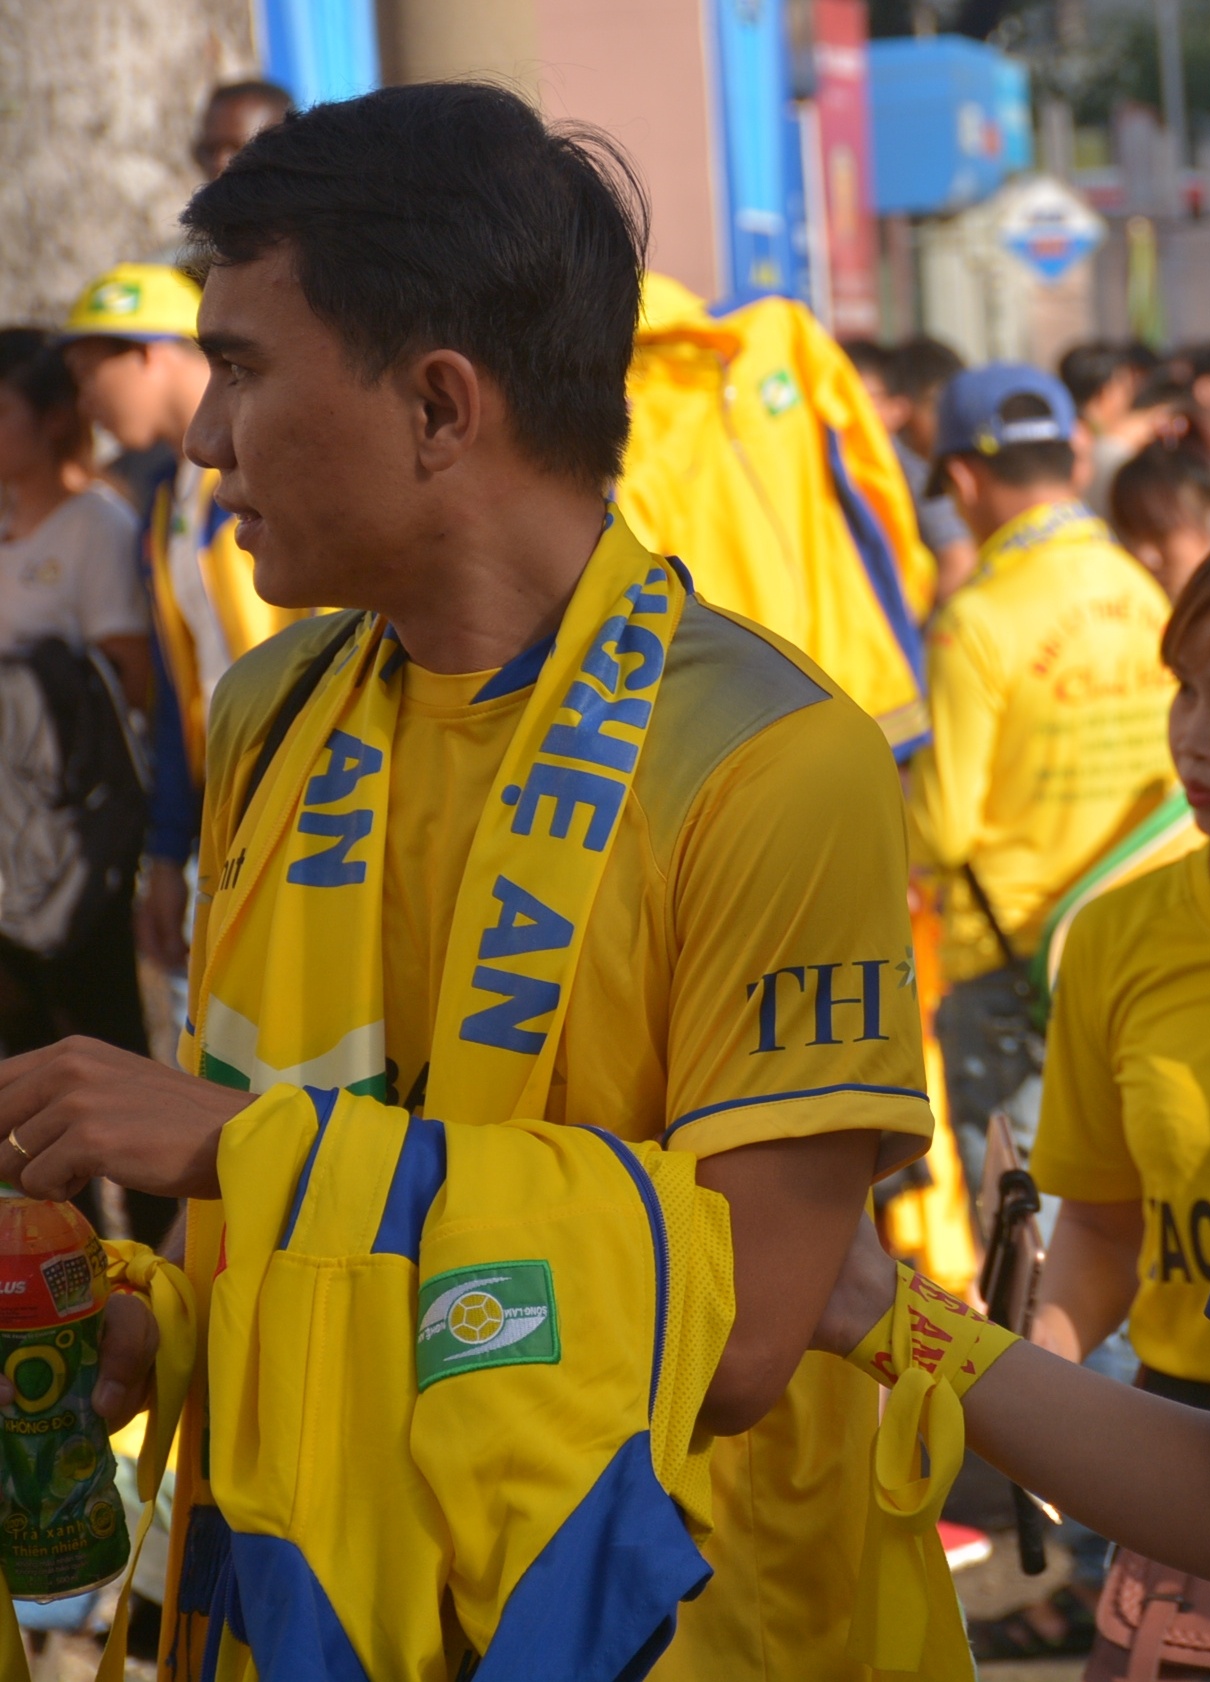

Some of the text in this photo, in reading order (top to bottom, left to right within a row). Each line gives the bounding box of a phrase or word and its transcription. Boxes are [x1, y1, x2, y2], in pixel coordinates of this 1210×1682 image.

[286, 728, 384, 888] AN
[459, 874, 575, 1056] AN
[746, 959, 890, 1056] TH
